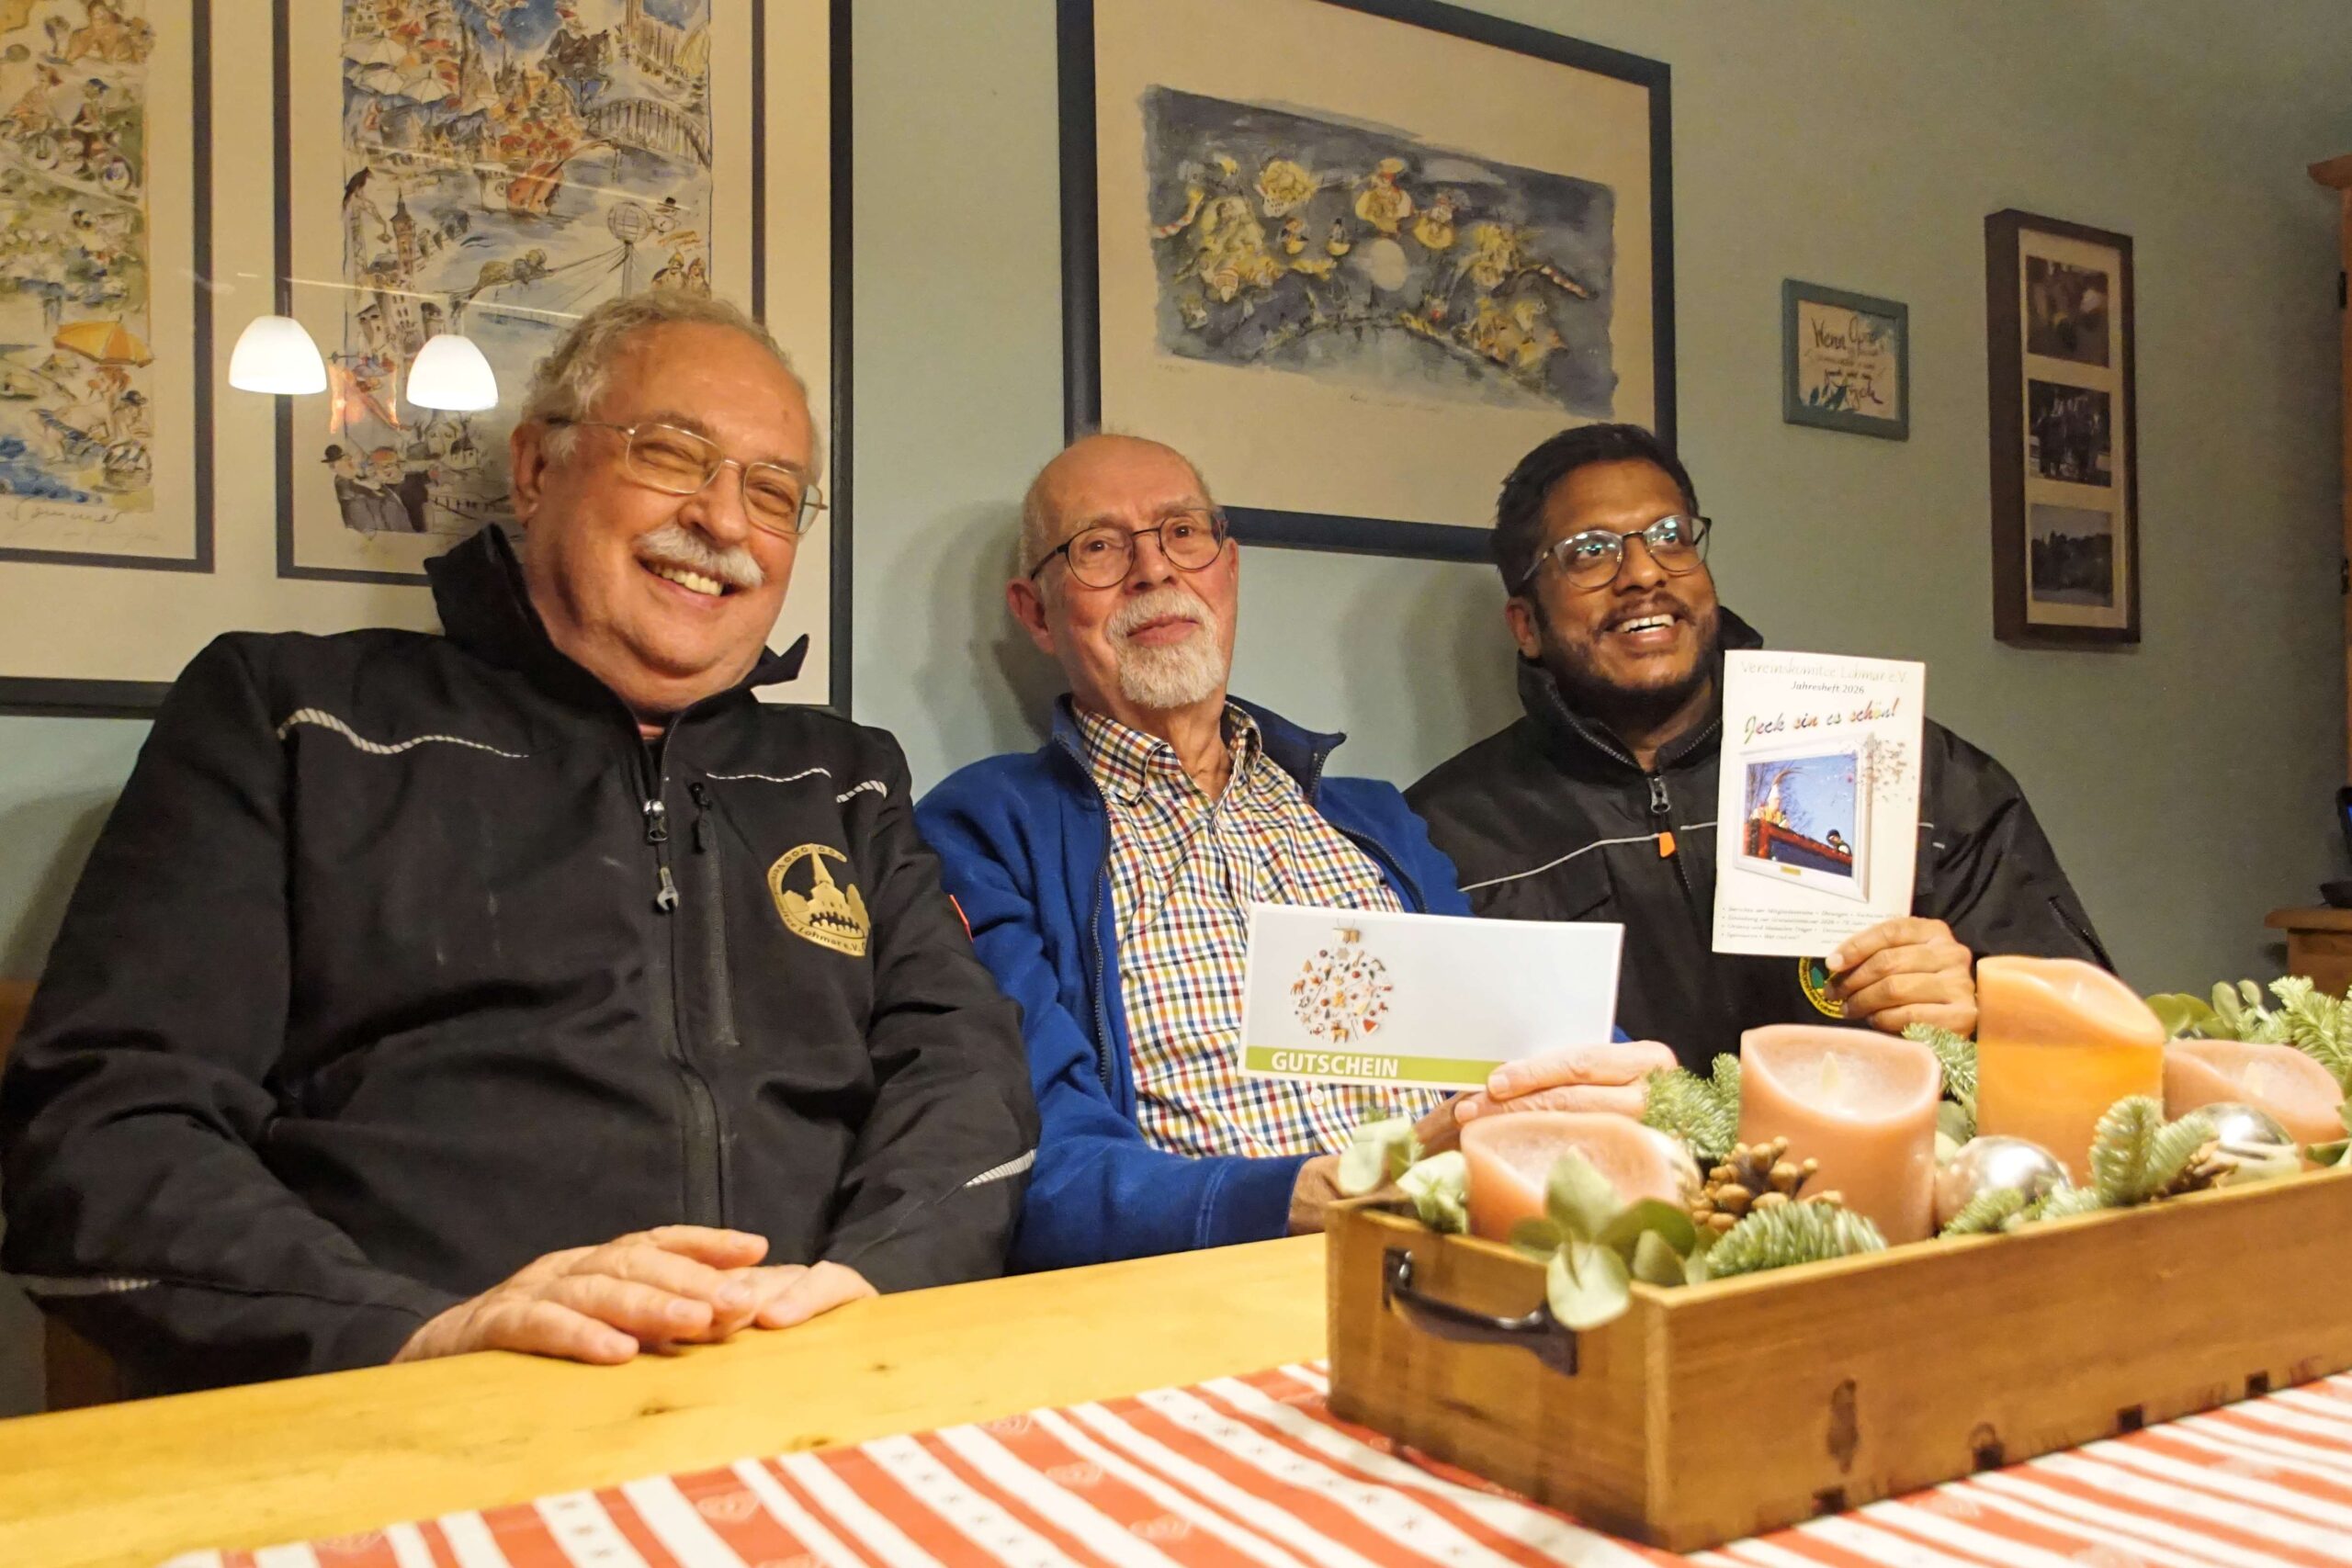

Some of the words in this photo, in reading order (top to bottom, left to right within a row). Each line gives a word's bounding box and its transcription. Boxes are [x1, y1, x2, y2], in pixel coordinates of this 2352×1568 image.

[1791, 681, 1839, 694] Jahresheft
[1842, 684, 1864, 694] 2026
[1744, 712, 1785, 745] Jeck
[1793, 712, 1818, 730] sin
[1826, 712, 1841, 726] es
[1849, 696, 1899, 723] schön!
[1271, 1051, 1399, 1077] GUTSCHEIN
